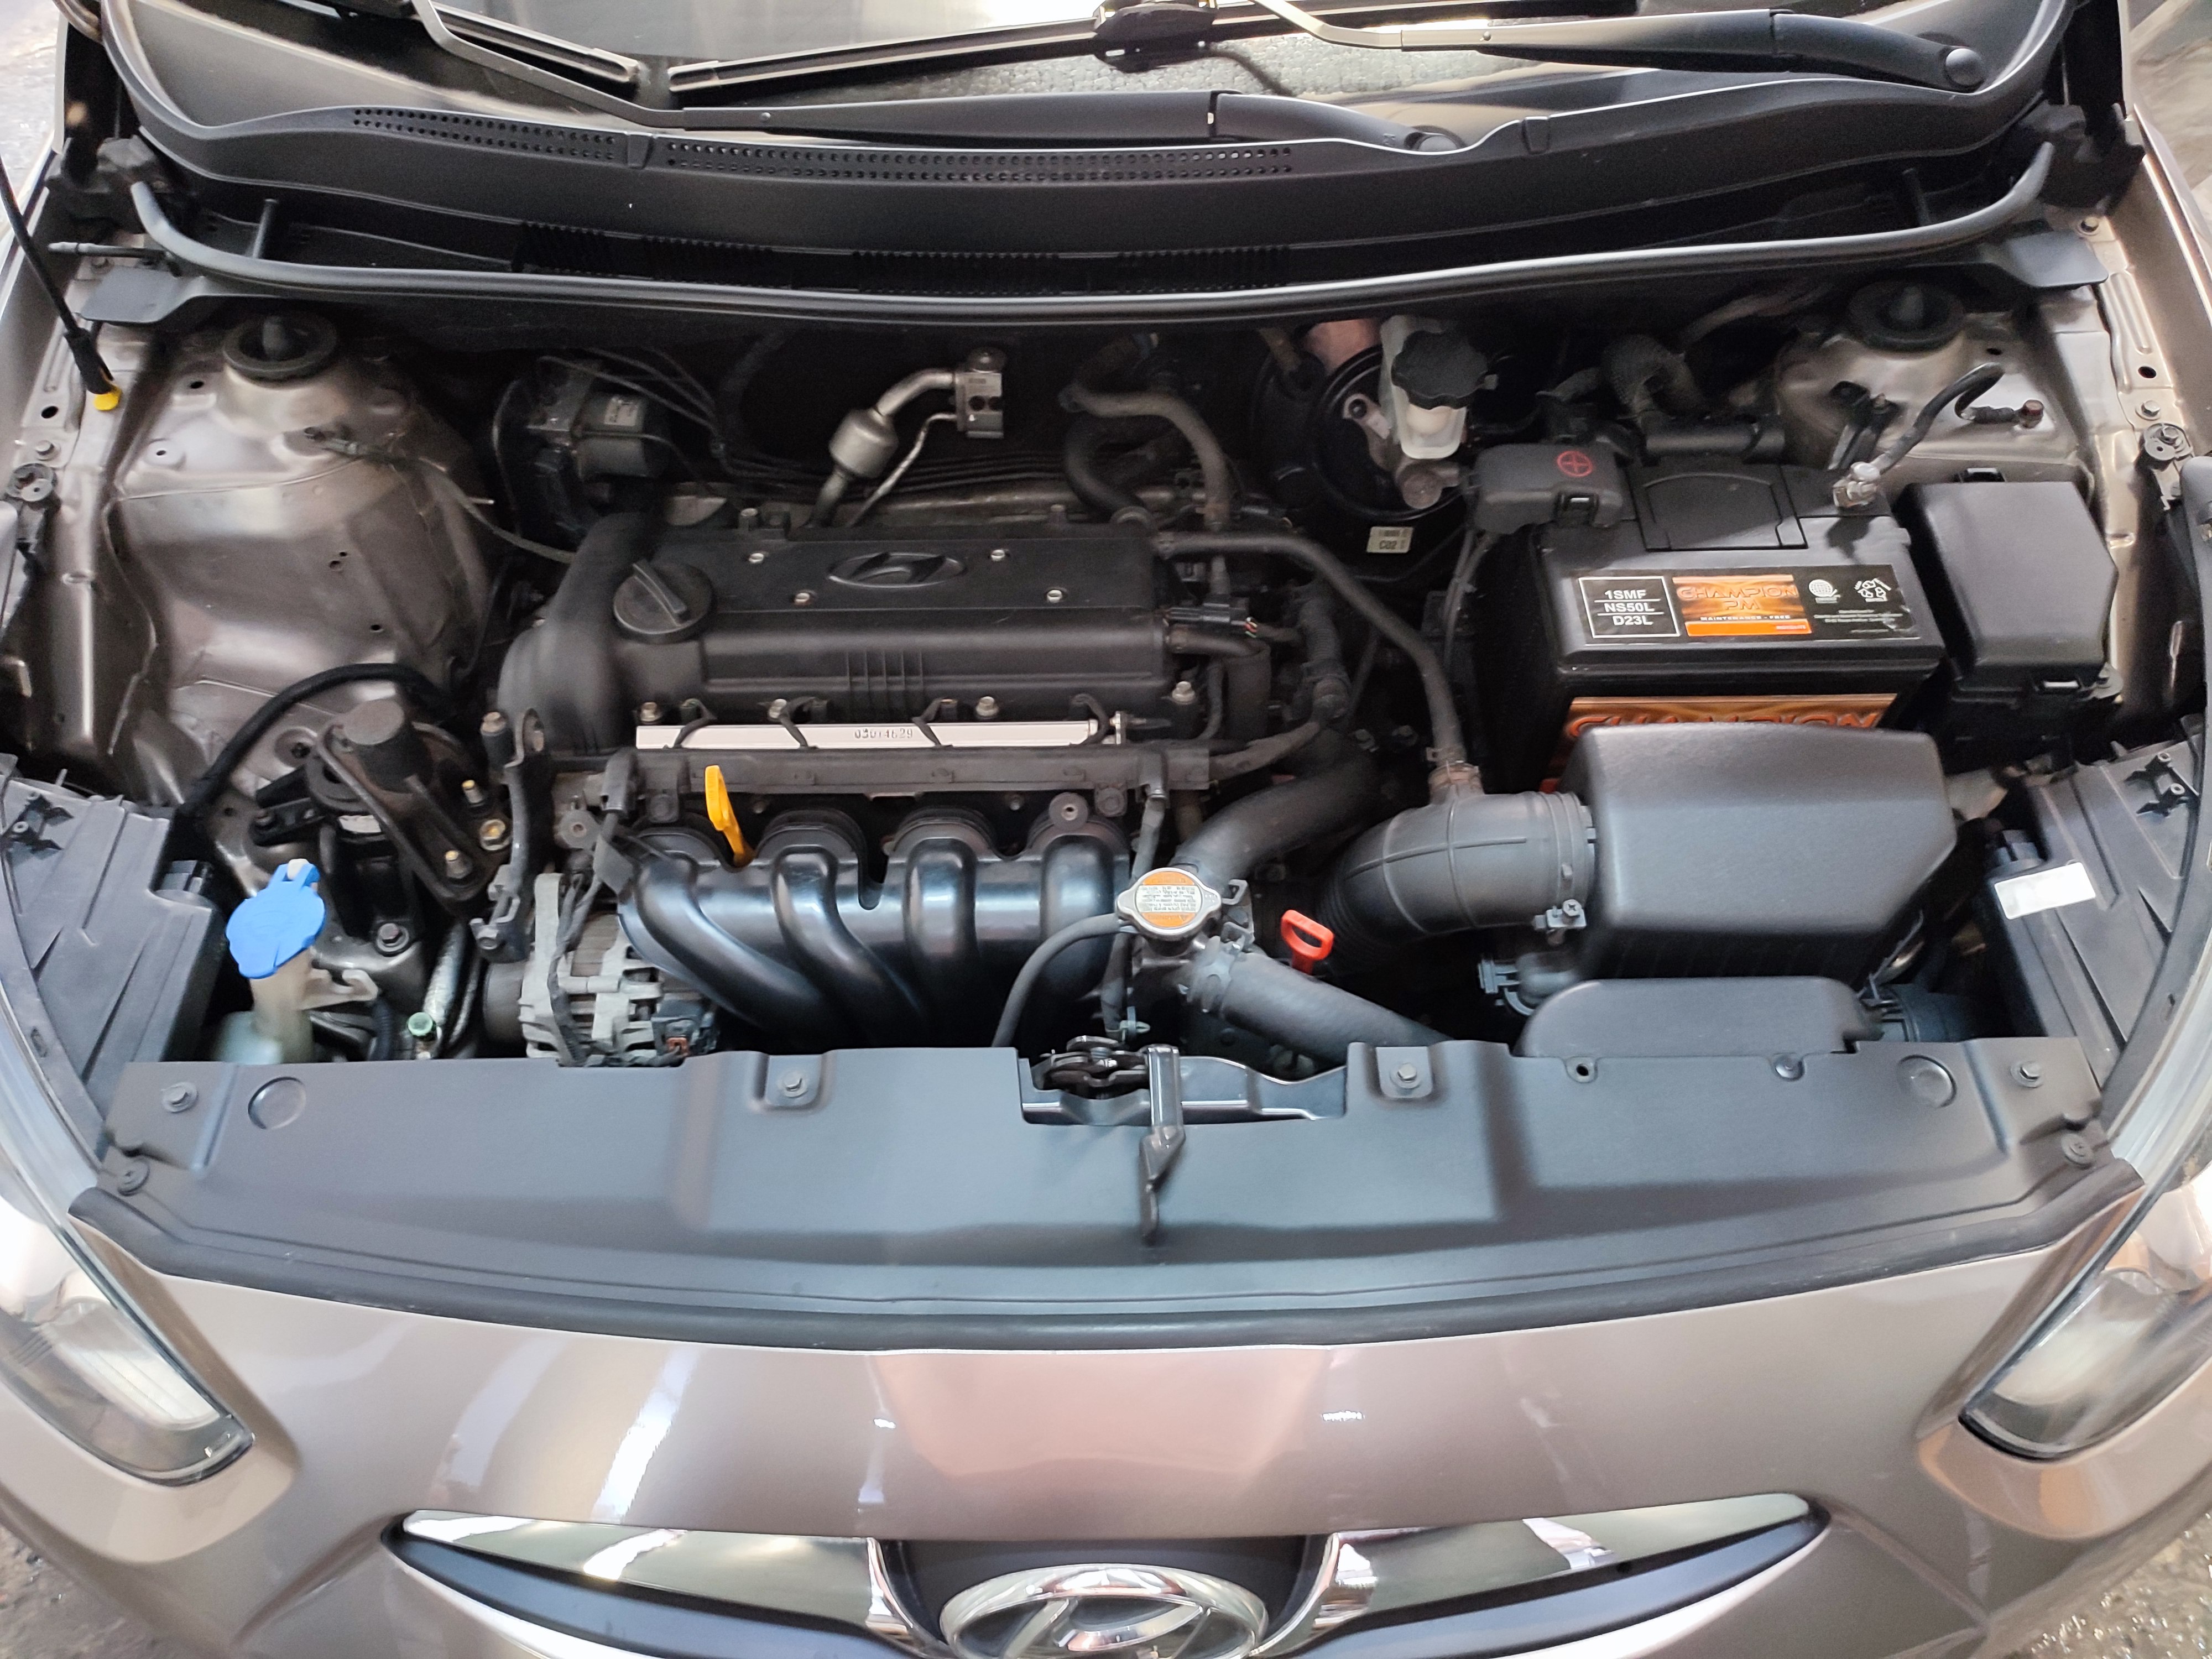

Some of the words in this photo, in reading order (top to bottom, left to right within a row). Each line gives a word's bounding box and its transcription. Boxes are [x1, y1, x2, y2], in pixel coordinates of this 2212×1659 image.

[1604, 589, 1647, 599] 1SMF
[1678, 585, 1798, 600] CHAMPION
[1604, 603, 1655, 612] NS50L
[1723, 599, 1760, 610] PM
[1613, 615, 1653, 625] D23L
